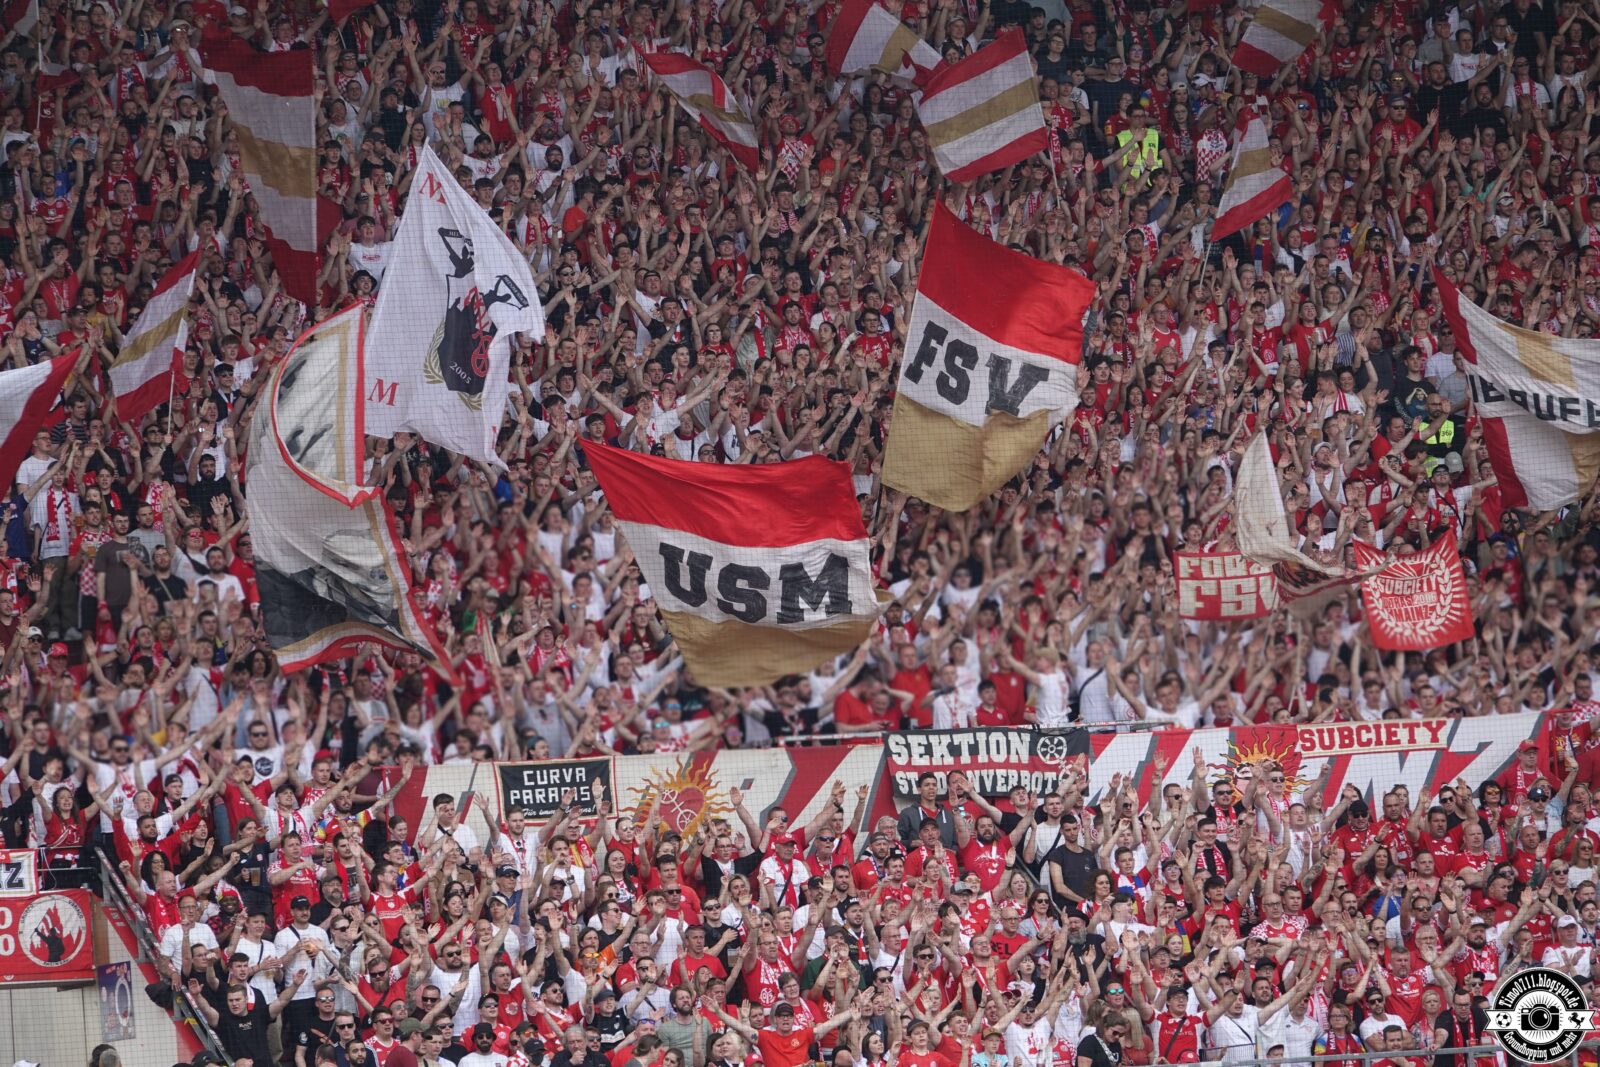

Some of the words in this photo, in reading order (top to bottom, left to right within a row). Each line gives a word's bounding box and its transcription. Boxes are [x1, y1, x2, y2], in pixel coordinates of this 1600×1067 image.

[449, 361, 472, 385] 2005
[904, 320, 1050, 416] FSV
[367, 378, 400, 406] M
[659, 541, 852, 624] USM
[888, 732, 1031, 766] SEKTION
[1301, 720, 1447, 751] SUBCIETY
[523, 767, 586, 786] CURVA
[896, 770, 1057, 795] STDNVERBOT
